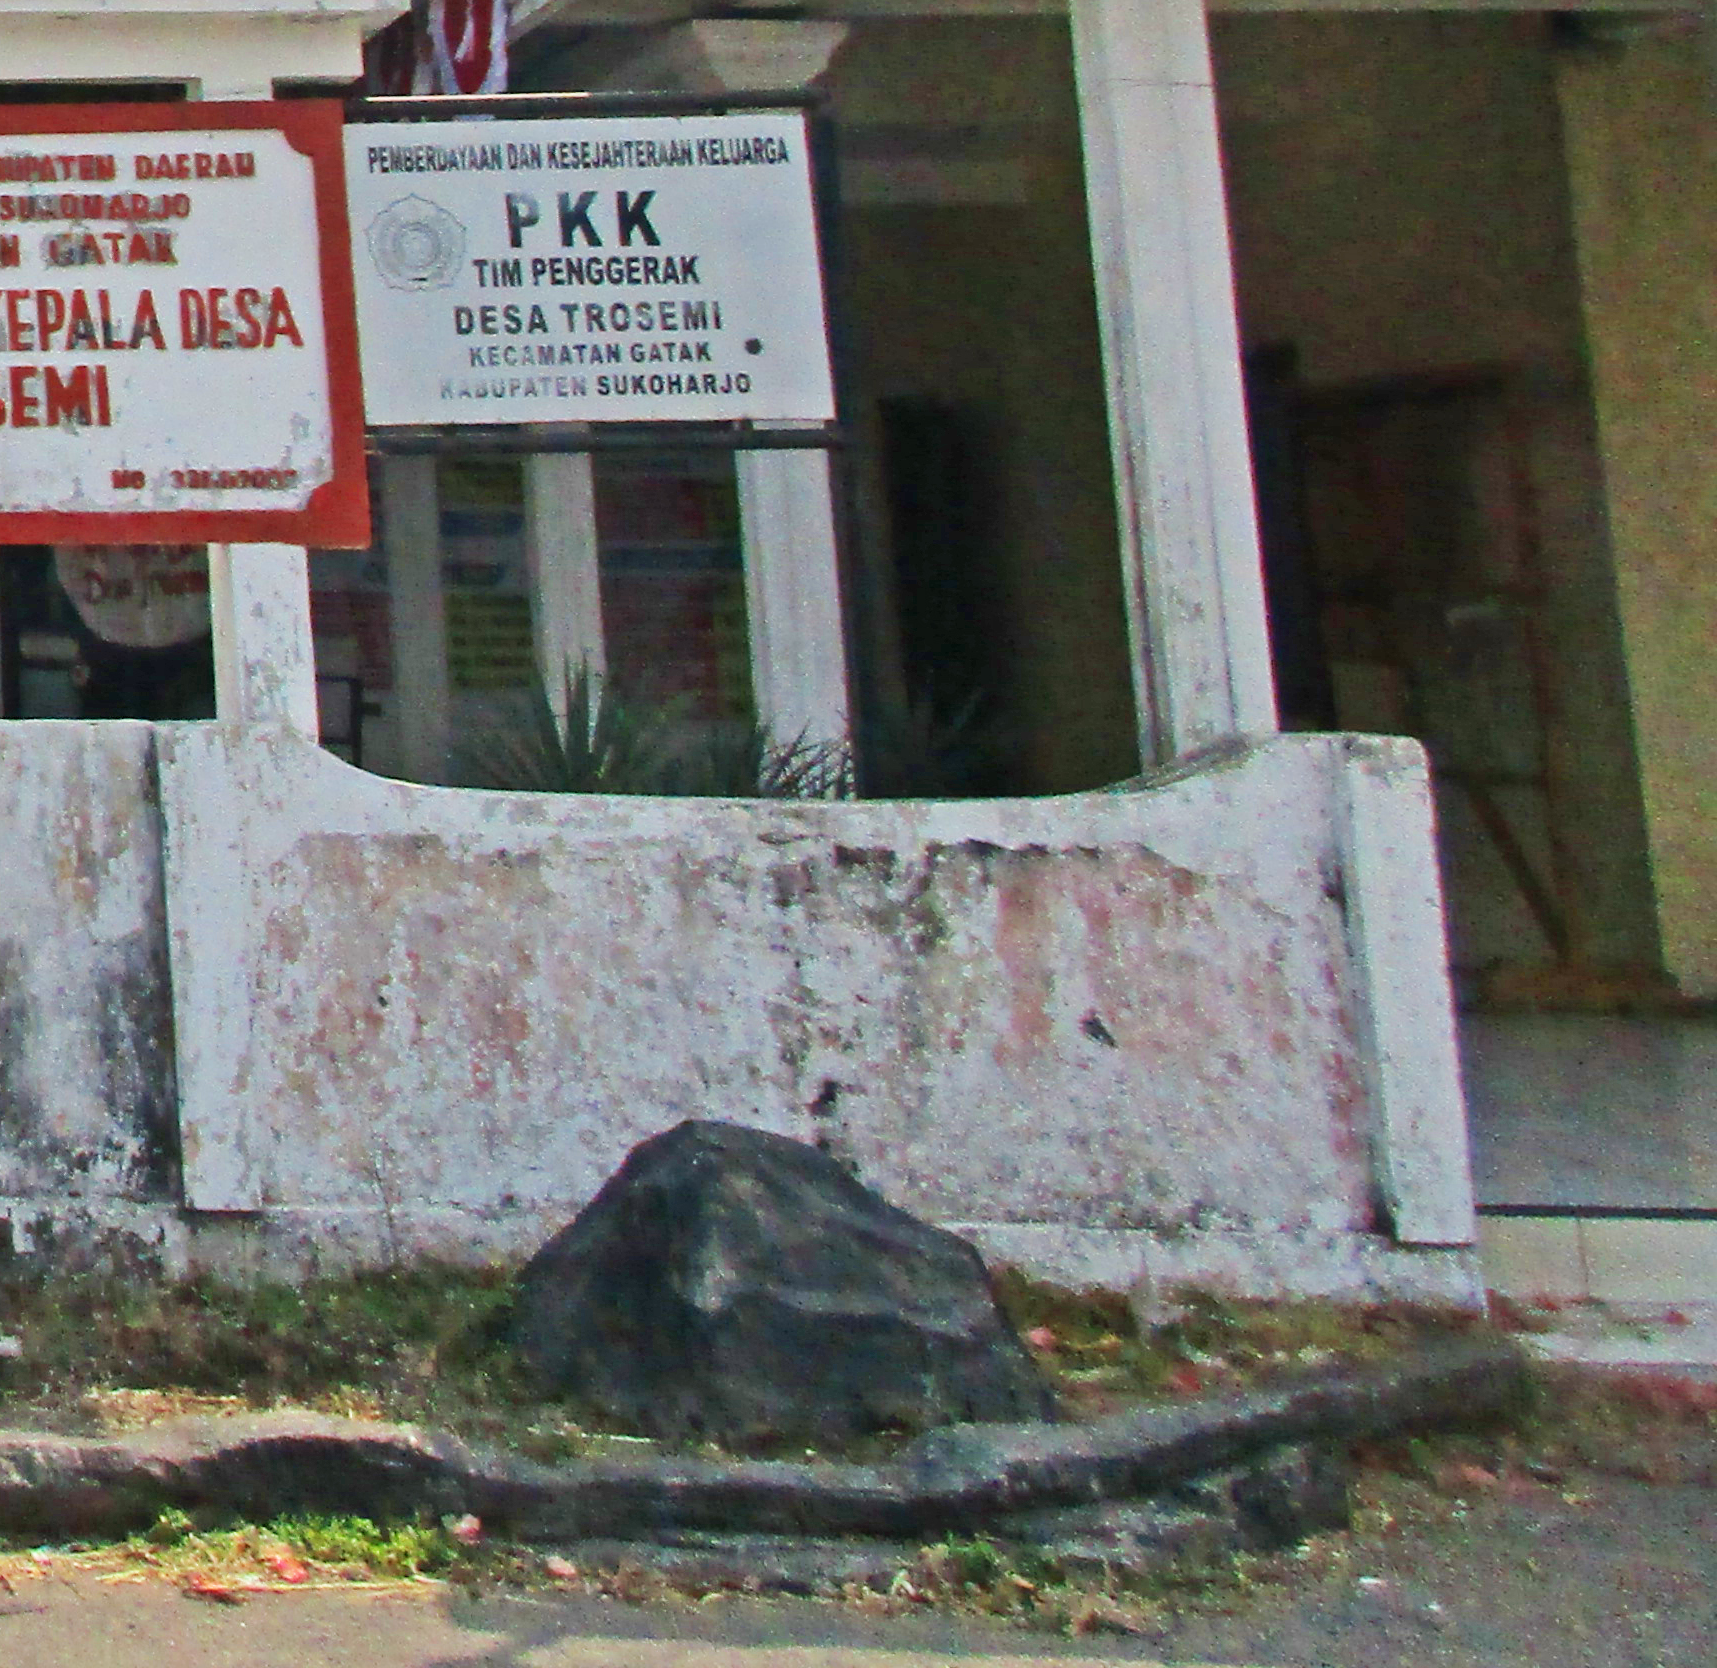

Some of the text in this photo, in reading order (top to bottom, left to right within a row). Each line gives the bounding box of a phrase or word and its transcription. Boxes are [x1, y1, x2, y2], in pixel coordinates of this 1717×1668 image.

[135, 152, 254, 180] DAERAH
[368, 137, 789, 173] PEMBERDAYAAN DAN KESEJAHTERAAN KELUARGA
[49, 232, 177, 267] GATAK
[473, 256, 700, 288] TIM PENGGERAK
[180, 286, 303, 350] DESA
[454, 301, 723, 335] DESA TROSEMI
[470, 342, 712, 368] KECAMATAN GATAK
[596, 373, 751, 395] SUKOHARJO
